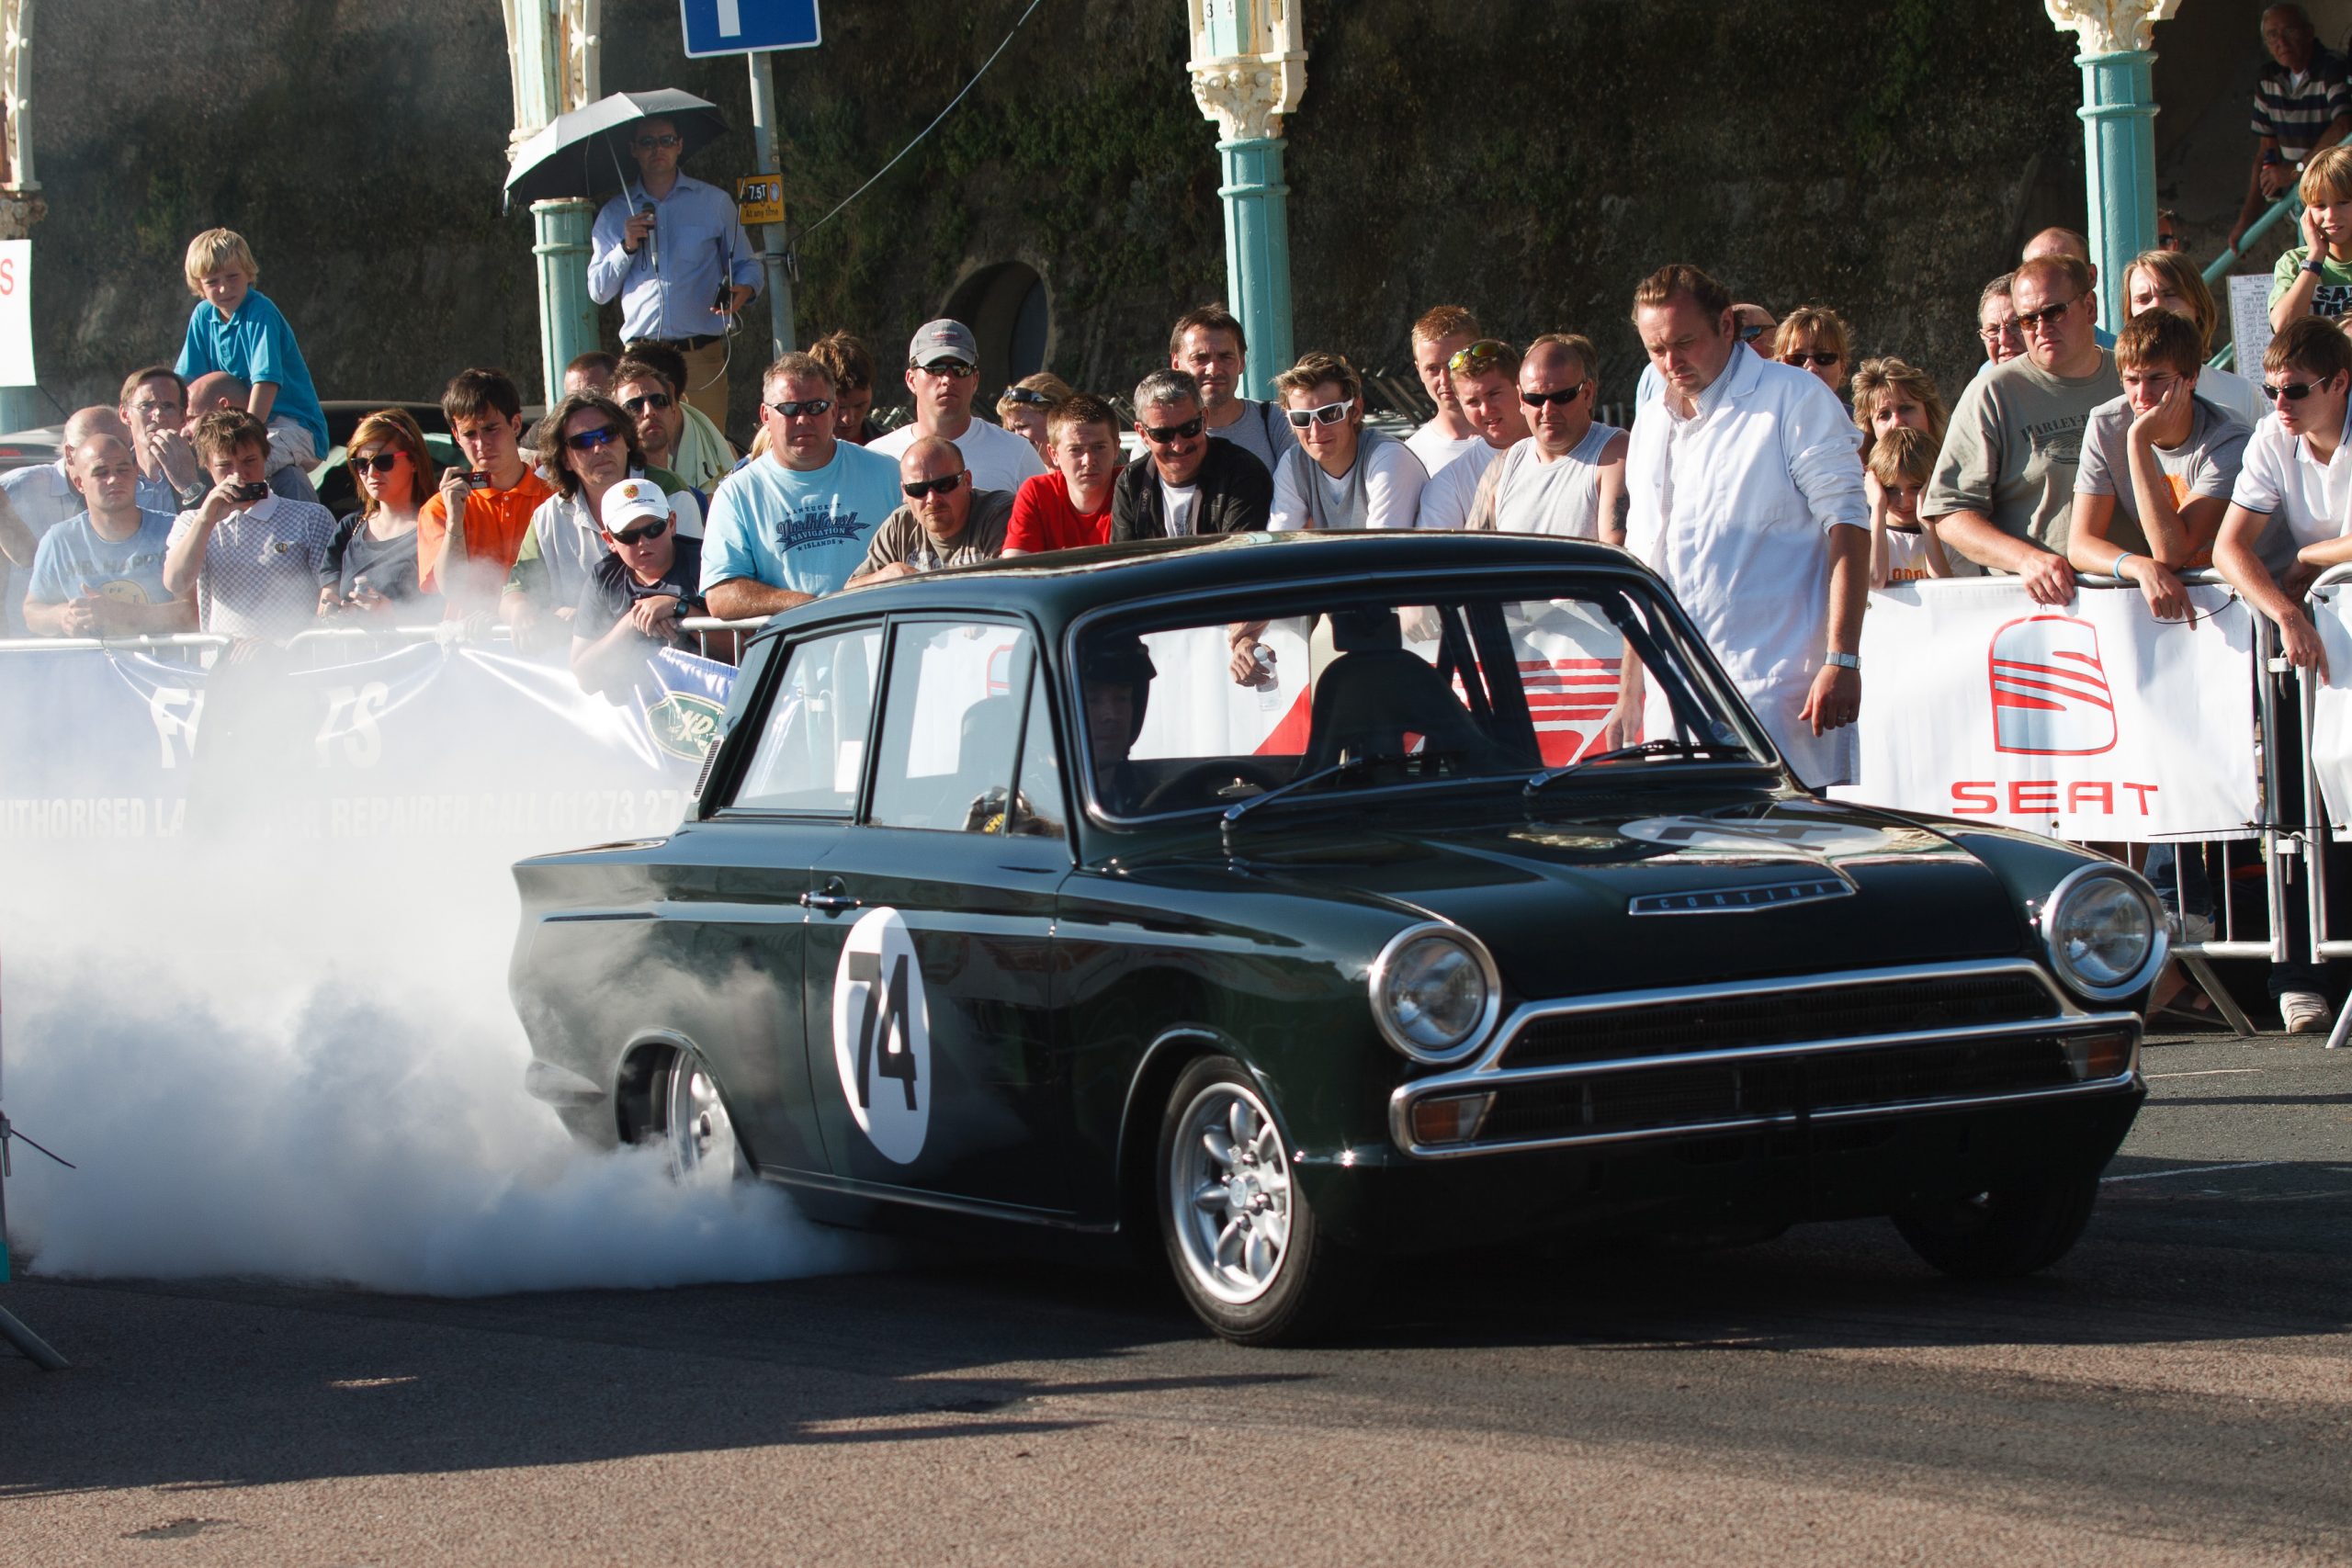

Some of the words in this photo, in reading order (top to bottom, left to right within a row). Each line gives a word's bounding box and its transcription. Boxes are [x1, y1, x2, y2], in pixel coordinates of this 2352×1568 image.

[749, 184, 767, 200] 7.5T
[2316, 285, 2352, 302] SA
[786, 502, 842, 516] NANTUCKET
[790, 527, 845, 542] NAVIGATION
[804, 538, 836, 550] ISLANDS
[1951, 780, 2159, 817] SEAT
[0, 797, 146, 839] UTHORISED
[155, 797, 187, 838] LA
[331, 794, 471, 840] REPAIRER
[550, 788, 635, 833] 01273
[645, 788, 691, 831] 27
[1660, 884, 1825, 908] CORTINA
[849, 951, 918, 1111] 74
